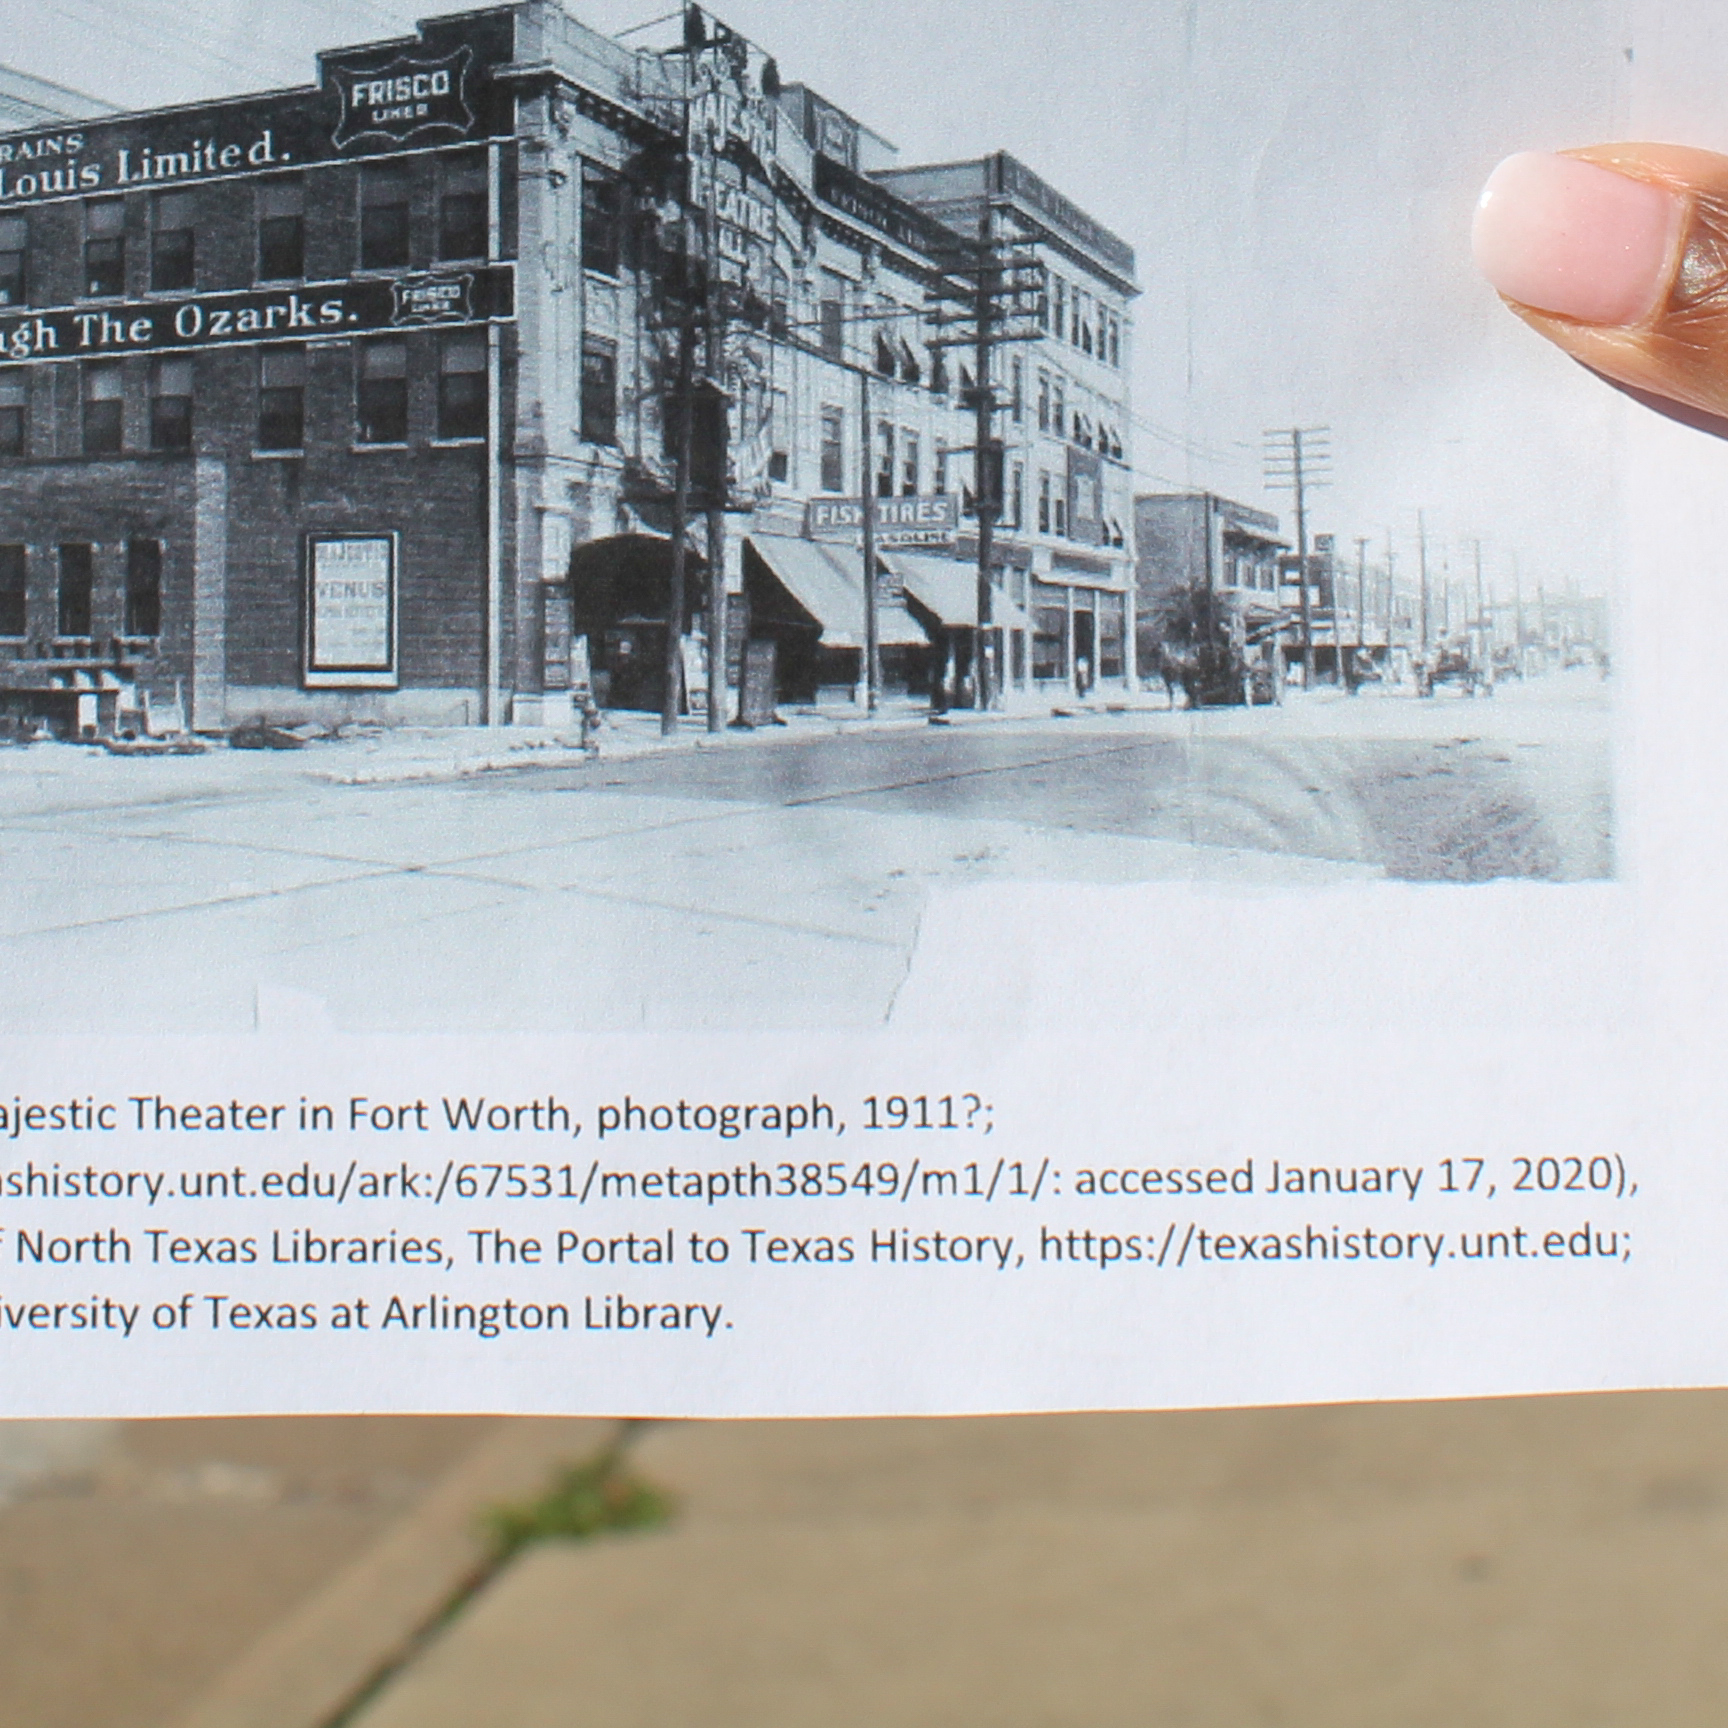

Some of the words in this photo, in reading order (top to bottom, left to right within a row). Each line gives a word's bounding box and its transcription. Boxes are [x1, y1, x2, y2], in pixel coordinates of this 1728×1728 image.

[351, 70, 450, 108] FRISCO
[117, 129, 291, 185] Limited.
[73, 311, 153, 347] The
[175, 294, 359, 339] Ozarks.
[877, 501, 948, 523] TIRES
[315, 581, 386, 599] VENUS
[129, 1096, 286, 1131] Theater
[300, 1097, 334, 1131] in
[349, 1097, 429, 1131] Fort
[442, 1095, 582, 1139] Worth,
[598, 1095, 846, 1140] photograph,
[863, 1093, 993, 1135] 1911?;
[1075, 1158, 1254, 1195] accessed
[1266, 1160, 1424, 1202] January
[1439, 1157, 1496, 1199] 17,
[1512, 1153, 1638, 1199] 2020),
[17, 1227, 131, 1264] North
[144, 1229, 258, 1264] Texas
[272, 1228, 454, 1271] Libraries,
[467, 1228, 542, 1264] The
[557, 1228, 674, 1264] Portal
[688, 1232, 730, 1264] to
[741, 1229, 855, 1264] Texas
[871, 1227, 1024, 1271] History,
[1040, 1221, 1631, 1270] https://texashistory.unt.edu;
[152, 1293, 194, 1330] of
[204, 1295, 318, 1330] Texas
[330, 1298, 370, 1330] at
[381, 1294, 569, 1339] Arlington
[585, 1294, 733, 1339] Library.
